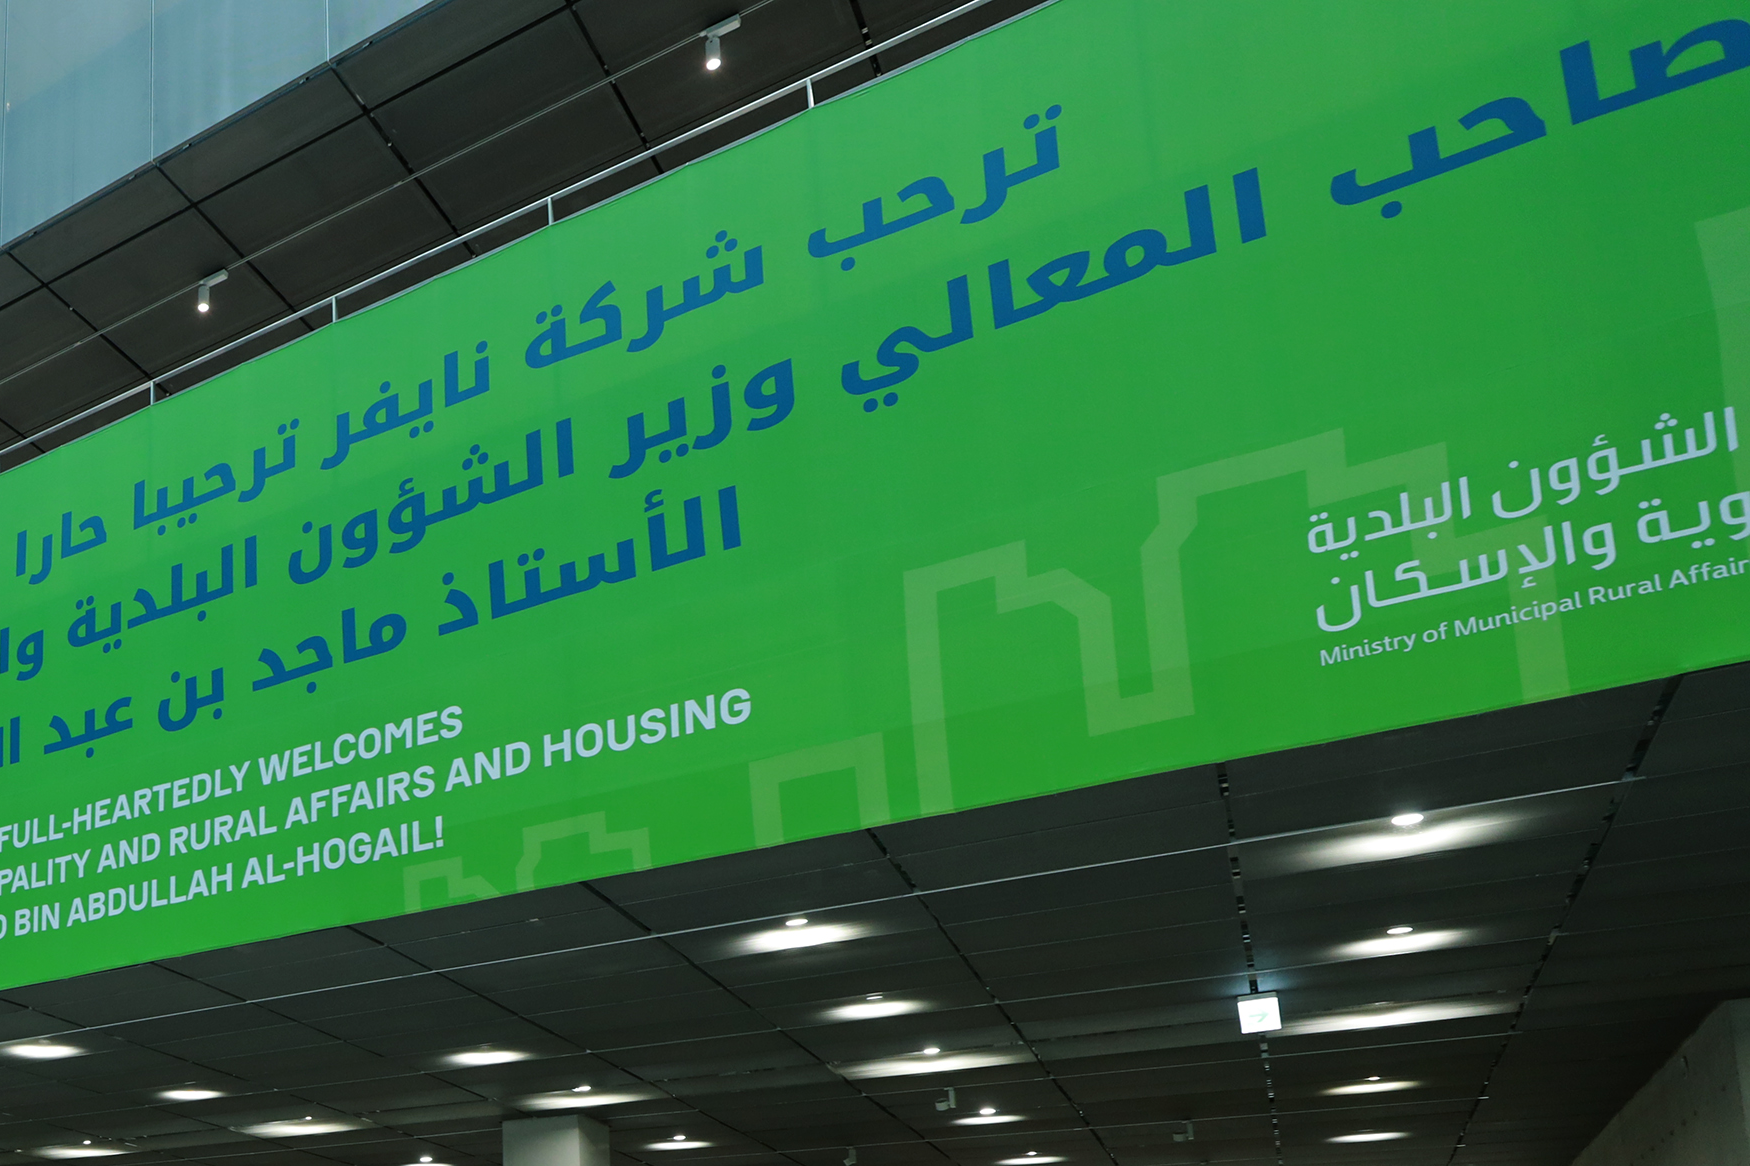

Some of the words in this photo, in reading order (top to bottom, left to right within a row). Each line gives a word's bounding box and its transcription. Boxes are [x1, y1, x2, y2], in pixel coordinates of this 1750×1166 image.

[807, 104, 1063, 272] ترحب
[525, 230, 765, 369] شركة
[841, 167, 1267, 413] المعالي
[320, 340, 490, 471] نايفر
[608, 358, 795, 479] وزير
[1492, 406, 1739, 519] الشؤون
[133, 418, 300, 536] ترحيبا
[288, 417, 575, 585] الشؤون
[1307, 476, 1471, 561] البلدية
[16, 511, 108, 585] حارا
[67, 535, 258, 654] البلدية
[438, 485, 742, 636] الأستاذ
[1316, 520, 1616, 632] والإسكان
[252, 607, 407, 694] ماجد
[1320, 632, 1417, 667] Ministry
[1422, 621, 1448, 643] of
[1454, 591, 1583, 637] Municipal
[1588, 574, 1663, 605] Rural
[44, 696, 133, 758] عبد
[158, 667, 225, 732] بن
[258, 705, 463, 786] WELCOMES
[96, 832, 161, 873] AND
[169, 805, 278, 857] RURAL
[284, 765, 436, 830] AFFAIRS
[444, 741, 531, 792] AND
[543, 688, 752, 767] HOUSING
[14, 902, 60, 937] BIN
[66, 862, 233, 927] ABDULLAH
[241, 815, 444, 889] AL-HOGAIL!
